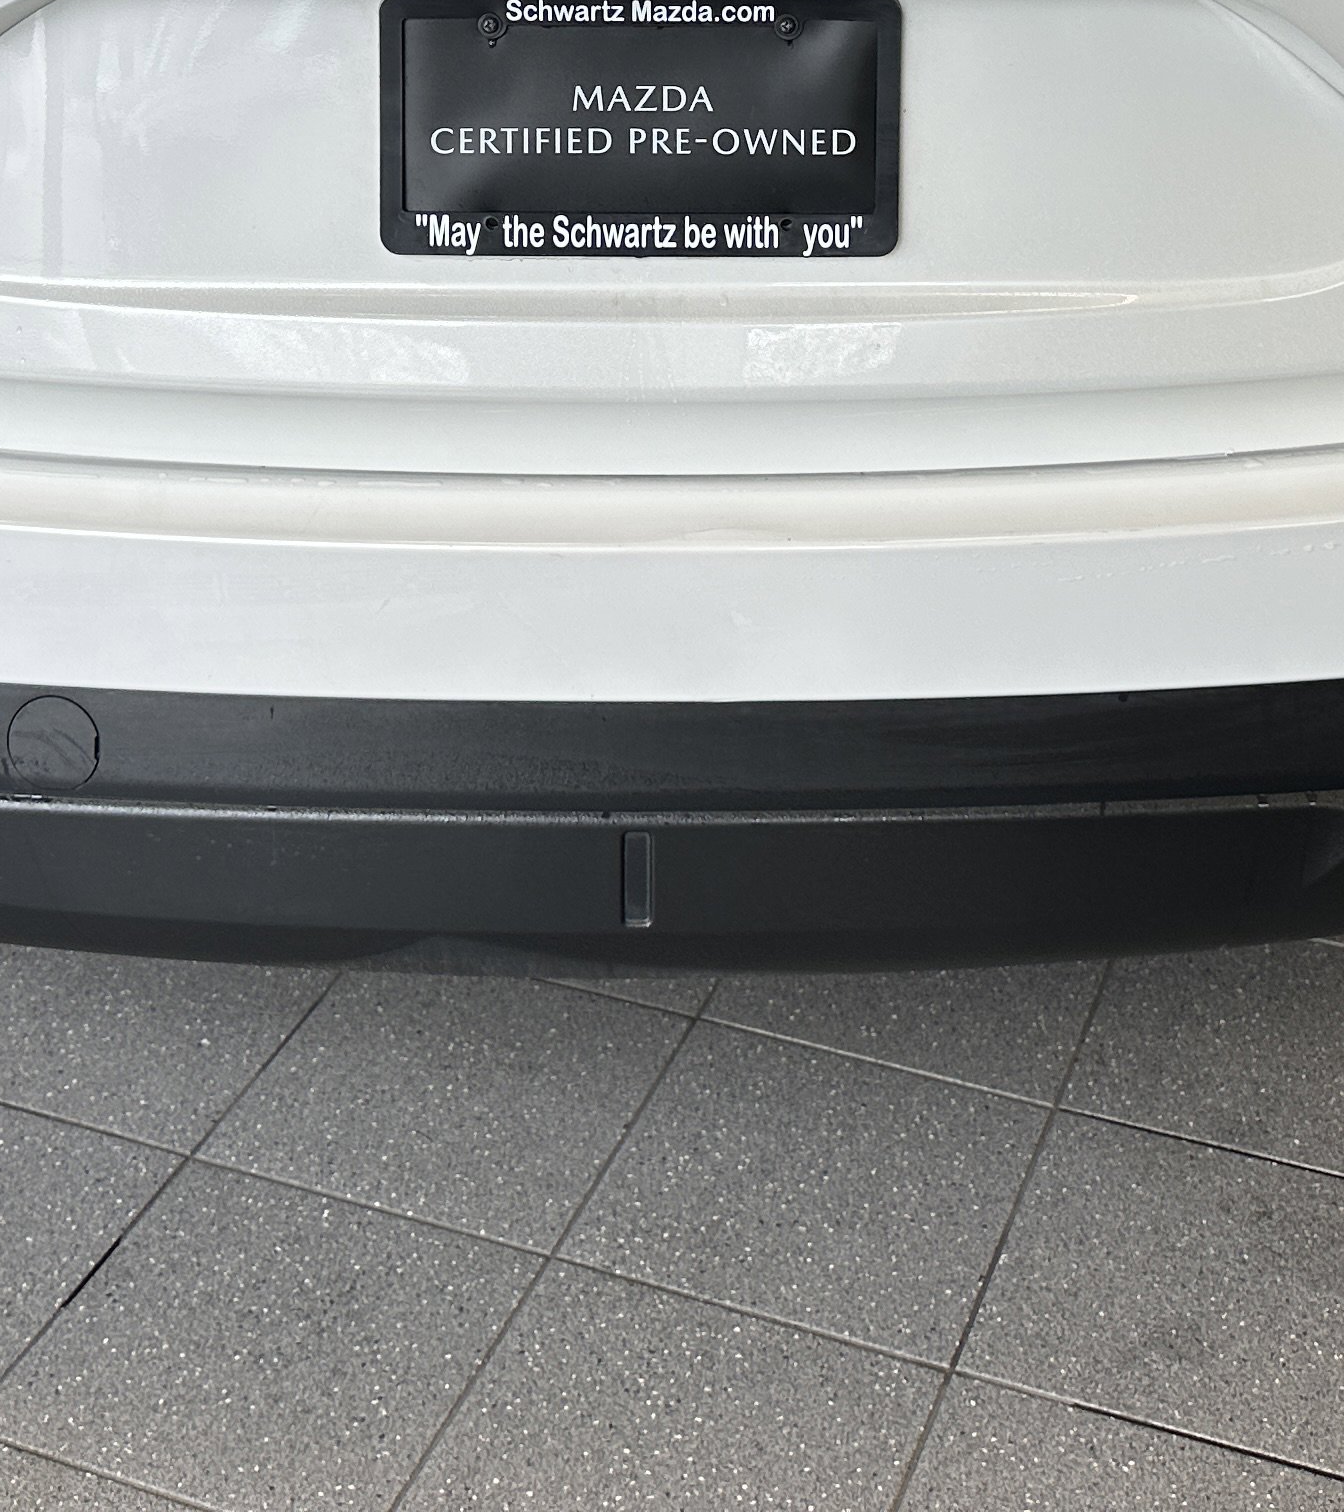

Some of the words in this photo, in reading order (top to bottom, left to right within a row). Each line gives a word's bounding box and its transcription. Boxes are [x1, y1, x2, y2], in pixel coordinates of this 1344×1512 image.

[505, 0, 625, 23] Schwartz
[631, 0, 776, 23] Mazda.com
[572, 85, 714, 112] MAZDA
[430, 127, 613, 155] CERTIFIED
[628, 128, 856, 156] PRE-OWNED
[415, 213, 482, 256] "May
[503, 215, 545, 248] the
[552, 215, 677, 249] Schwartz
[684, 215, 715, 249] be
[724, 215, 779, 249] with
[802, 215, 863, 257] you"
